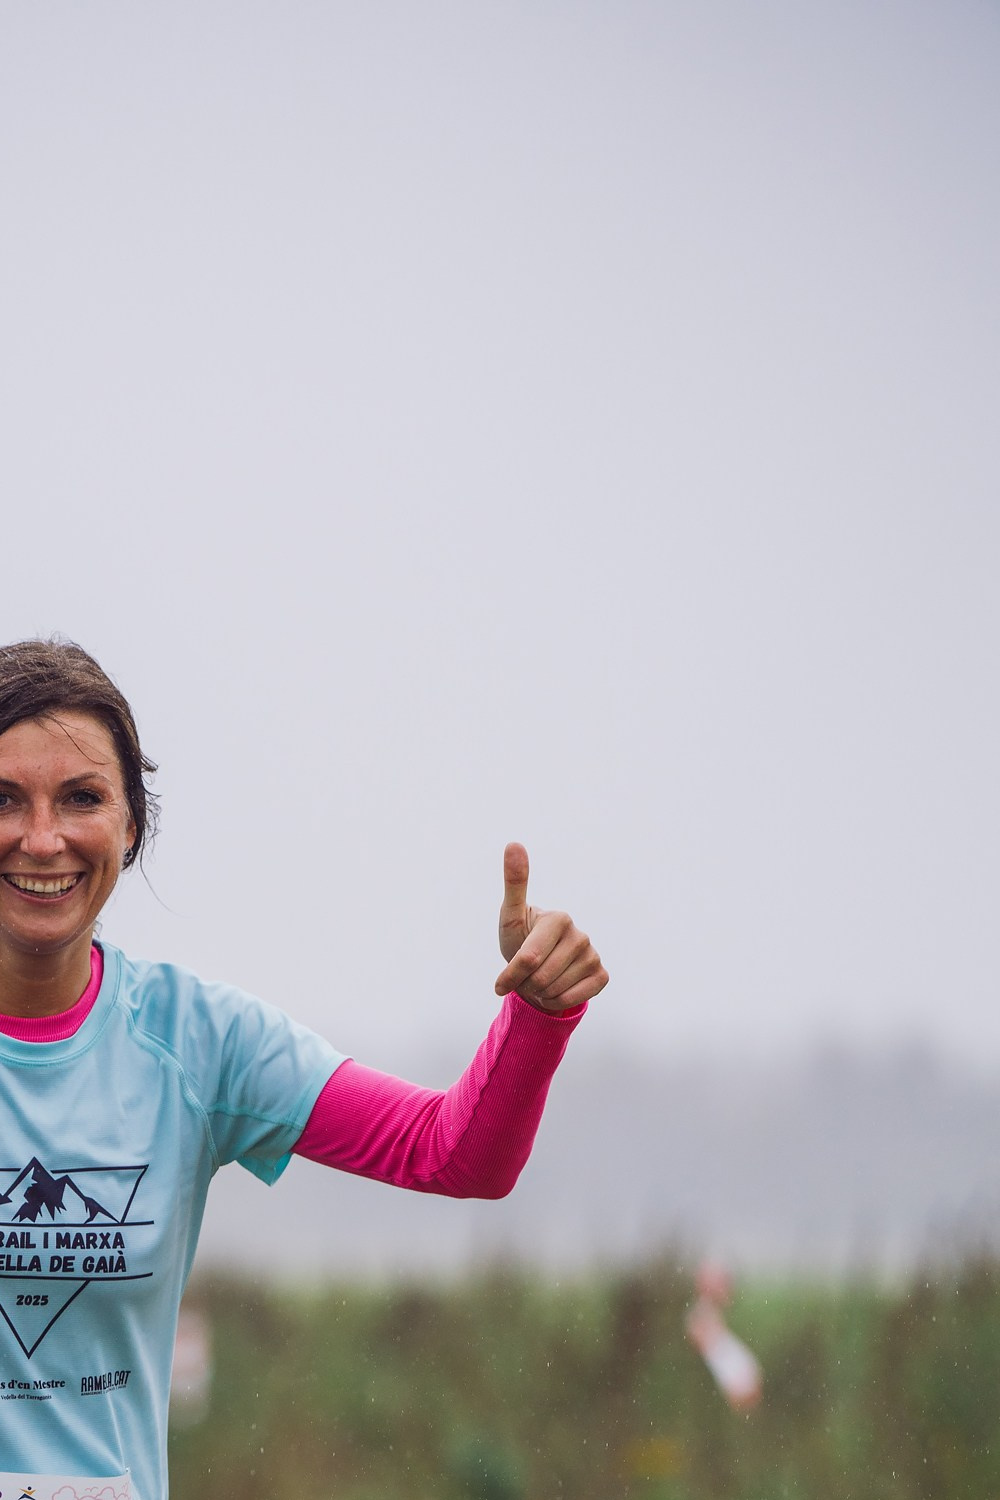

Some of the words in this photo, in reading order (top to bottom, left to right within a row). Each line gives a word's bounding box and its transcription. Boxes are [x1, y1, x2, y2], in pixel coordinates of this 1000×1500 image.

[43, 1232, 49, 1249] I
[56, 1232, 125, 1249] MARXA
[50, 1255, 76, 1273] DE
[82, 1250, 127, 1273] GAIÀ
[16, 1295, 49, 1306] 2025
[8, 1380, 30, 1390] d'en
[33, 1380, 66, 1390] Mestre
